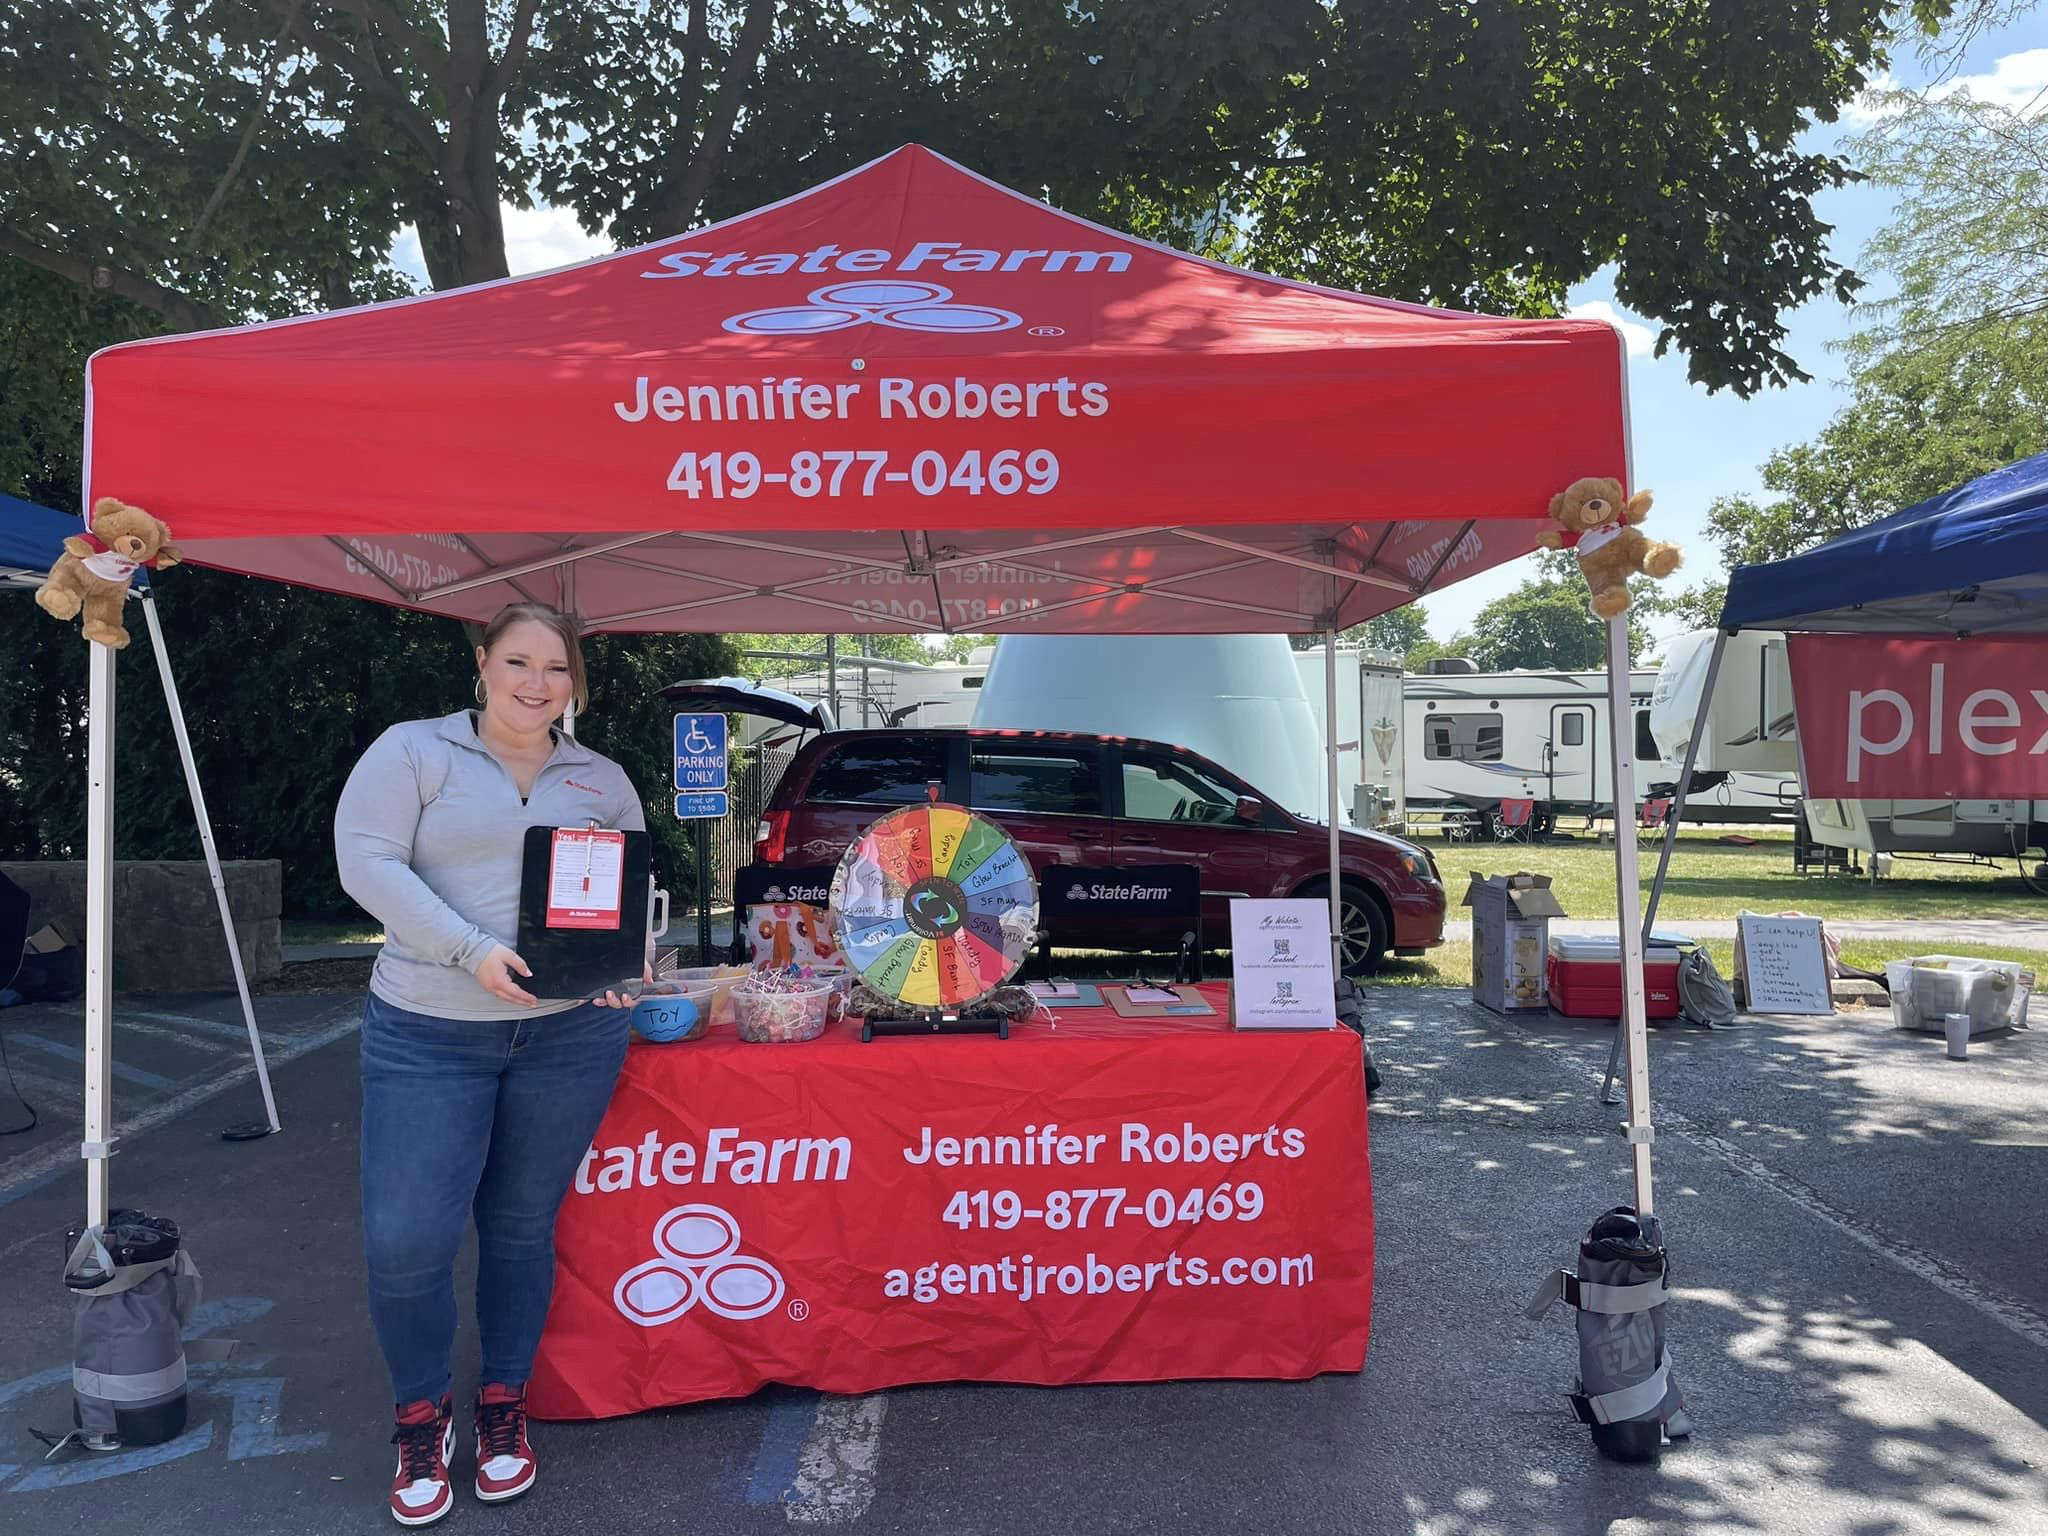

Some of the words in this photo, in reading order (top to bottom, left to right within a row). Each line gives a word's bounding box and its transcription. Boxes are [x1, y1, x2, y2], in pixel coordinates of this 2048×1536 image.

[614, 376, 861, 422] Jennifer
[880, 376, 1110, 419] Roberts
[666, 448, 1060, 499] 419-877-0469
[678, 756, 723, 769] PARKING
[687, 771, 715, 783] ONLY
[558, 832, 576, 841] Yes!
[935, 833, 956, 864] Candy
[787, 886, 828, 901] State
[981, 897, 993, 906] SF
[880, 904, 894, 916] SF
[864, 924, 897, 943] Candy
[1752, 924, 1763, 934] I
[1786, 927, 1805, 938] help
[911, 944, 933, 973] Candy
[957, 934, 981, 969] Candy
[904, 1124, 1106, 1166] Jennifer
[1120, 1122, 1306, 1163] Roberts
[942, 1182, 1264, 1230] 419-877-0469
[884, 1250, 1314, 1302] agentjroberts.com
